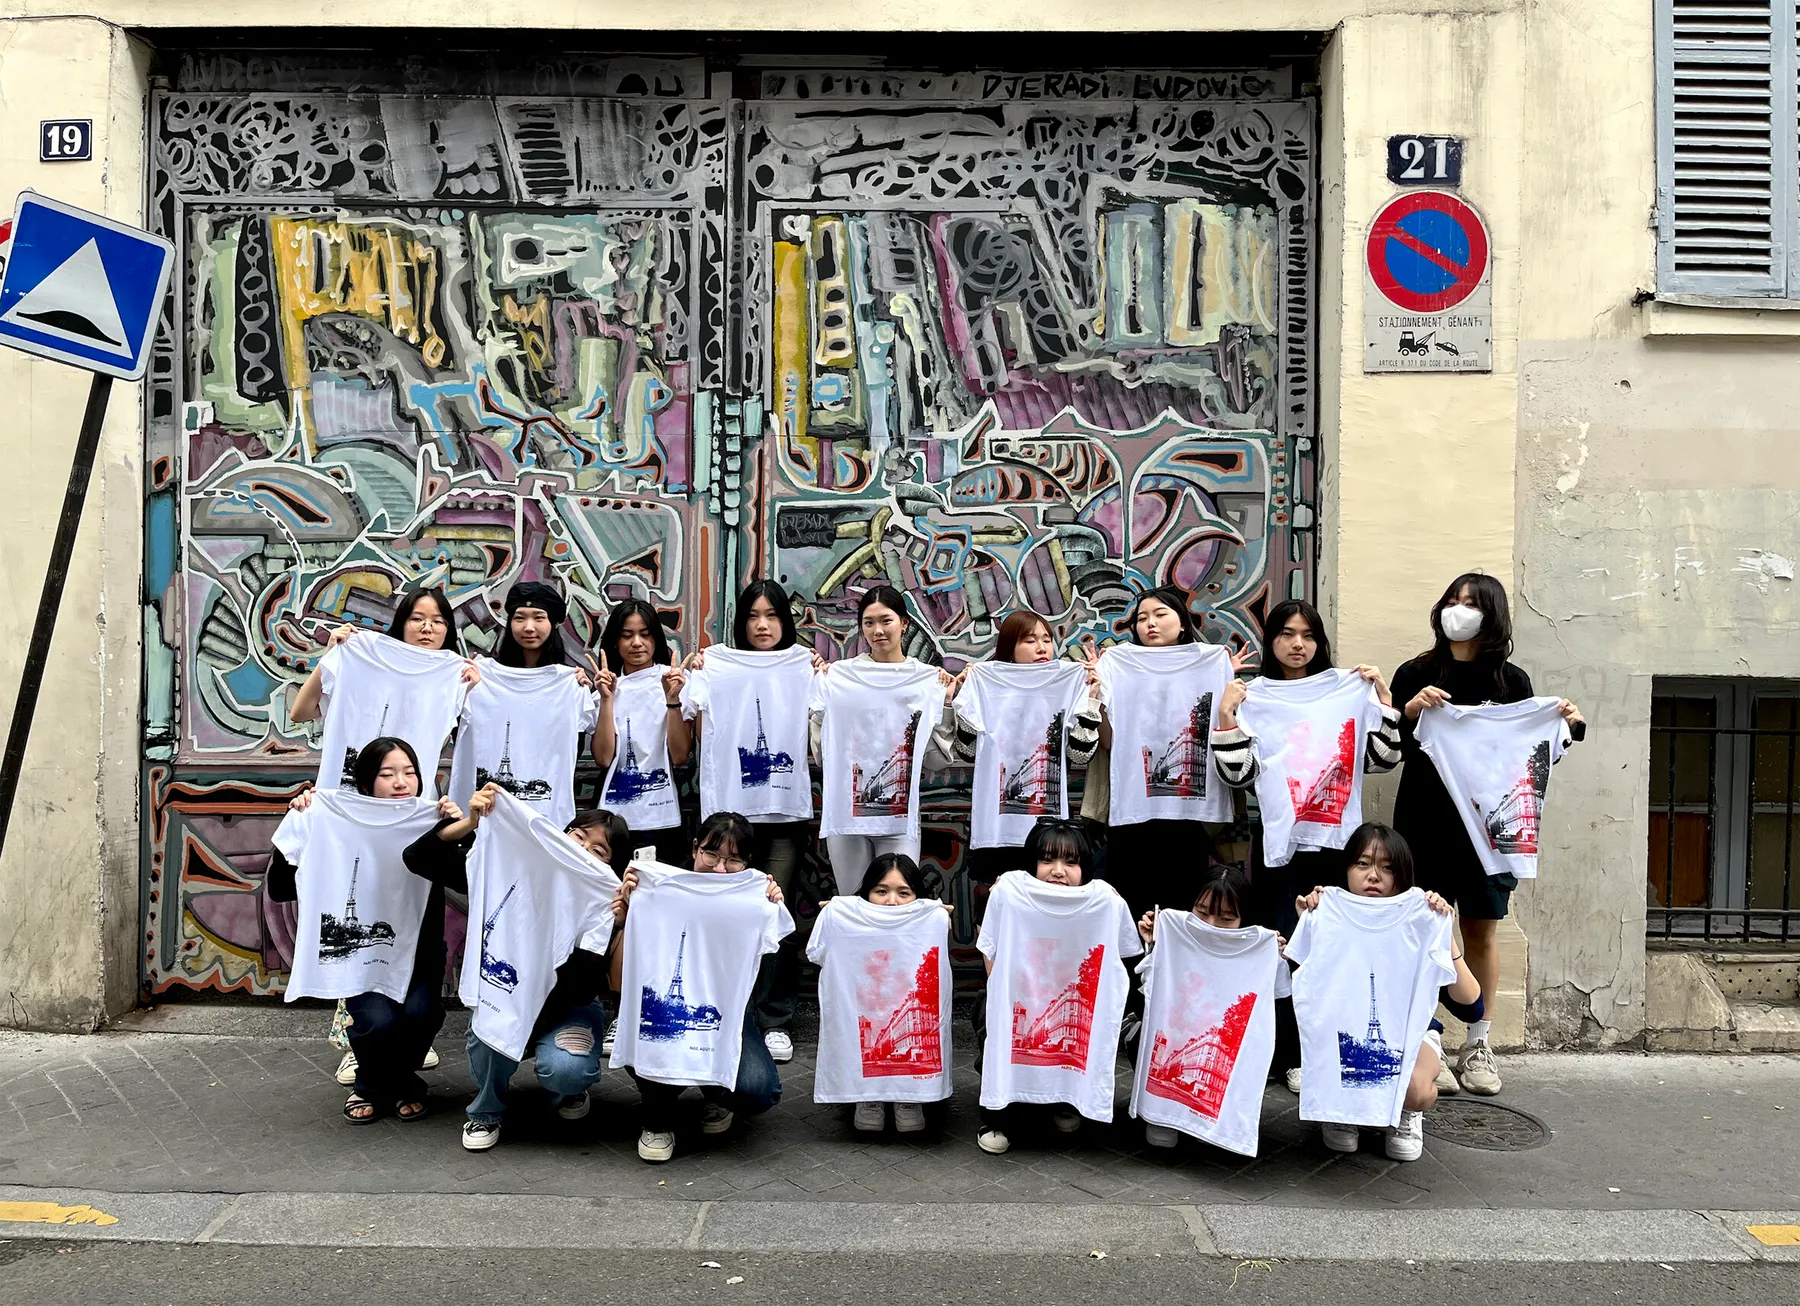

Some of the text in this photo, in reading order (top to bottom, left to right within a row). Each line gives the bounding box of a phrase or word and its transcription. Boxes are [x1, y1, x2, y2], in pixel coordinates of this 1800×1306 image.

[47, 125, 82, 155] 19
[1399, 139, 1448, 178] 21
[1379, 316, 1442, 328] STATIONNEMENT
